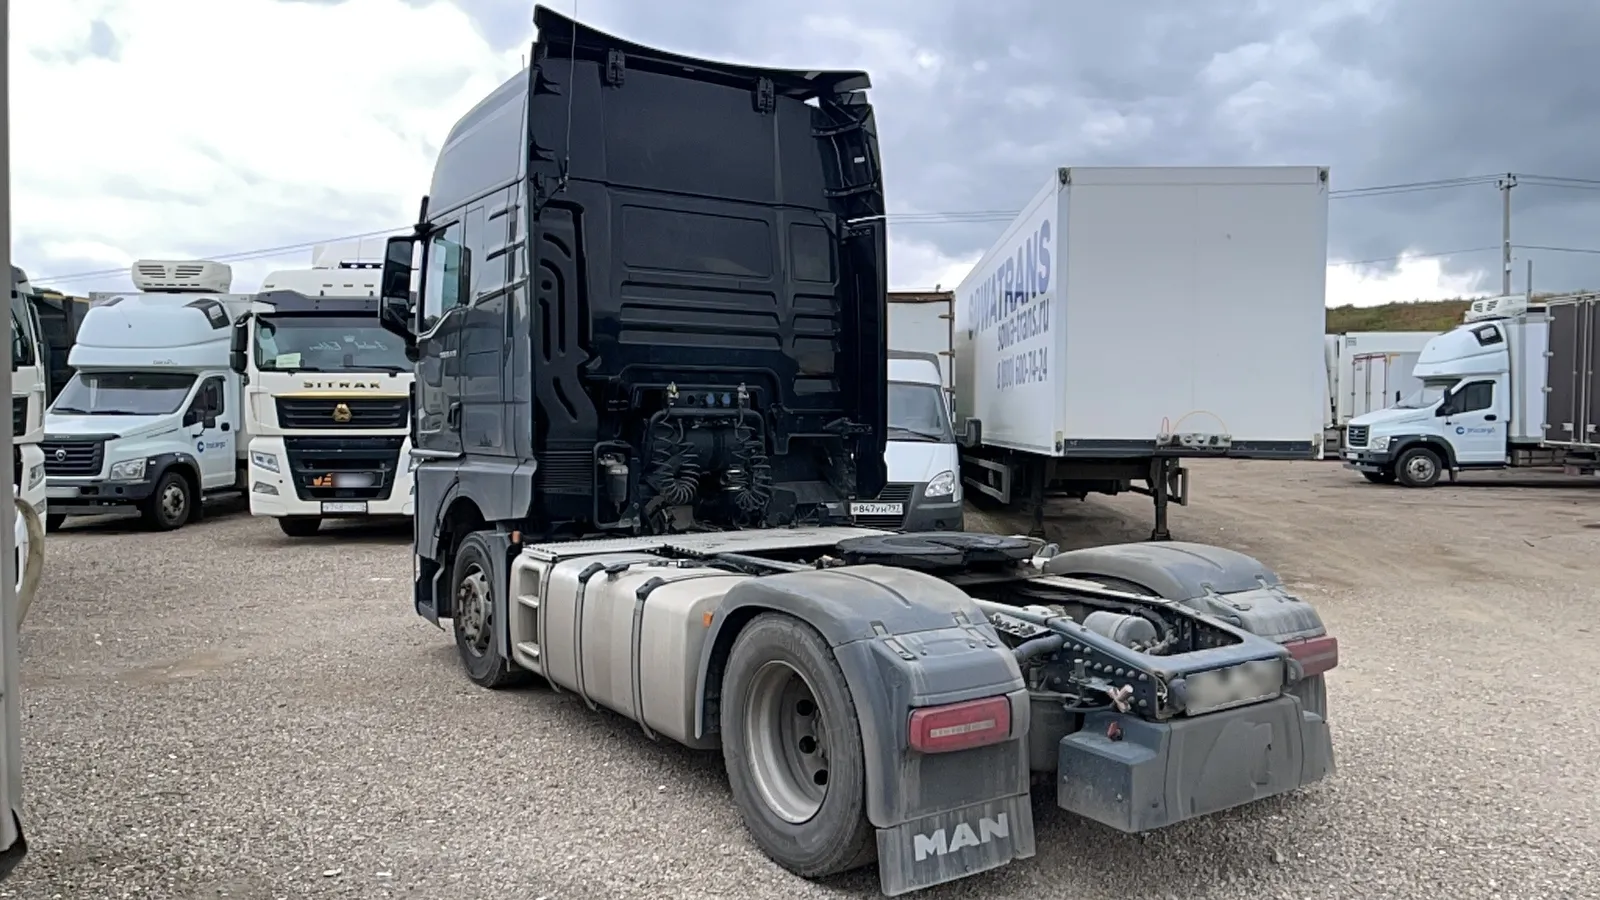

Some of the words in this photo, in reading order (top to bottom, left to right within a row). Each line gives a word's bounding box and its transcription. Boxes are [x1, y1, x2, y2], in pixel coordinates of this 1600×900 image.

[968, 219, 1051, 341] SOWATRANS
[303, 381, 381, 389] SITRAK
[913, 812, 1010, 862] MAN
